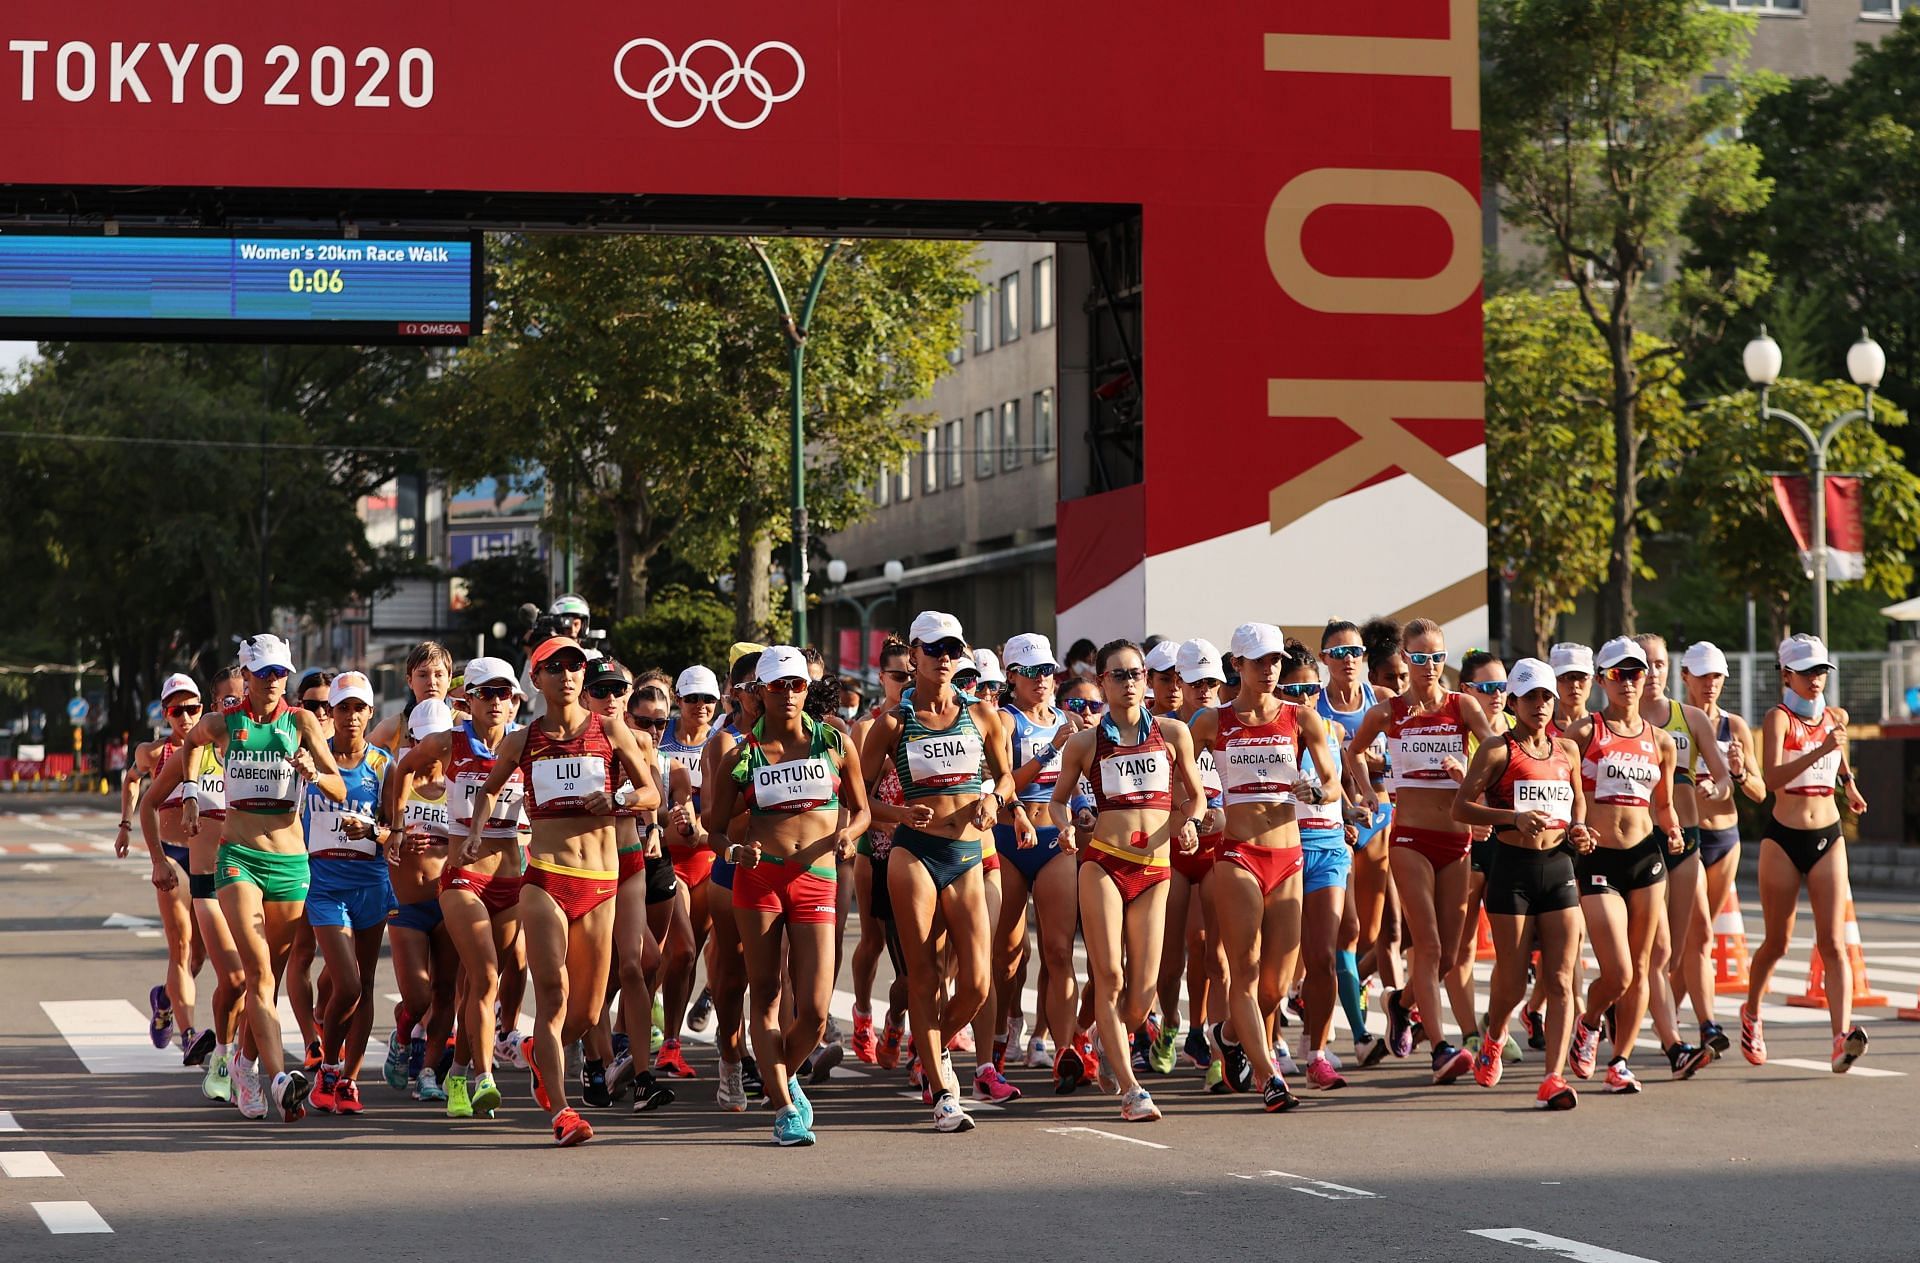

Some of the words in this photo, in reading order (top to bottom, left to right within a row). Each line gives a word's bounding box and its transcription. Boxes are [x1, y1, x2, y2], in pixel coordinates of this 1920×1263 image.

[9, 40, 244, 105] TOKYO
[263, 44, 435, 109] 2020
[240, 244, 314, 260] Women's
[318, 245, 362, 261] 20km
[366, 246, 405, 262] Race
[408, 247, 449, 263] Walk
[288, 267, 344, 294] 0:06
[420, 324, 462, 335] OMEGA
[1400, 723, 1457, 735] ESPAÑA
[1226, 734, 1291, 747] ESPAÑA
[1401, 741, 1463, 753] R.GONZALEZ
[923, 740, 966, 759] SENA
[1606, 750, 1649, 764] JAPAN
[230, 767, 292, 780] CABECINHA
[556, 763, 581, 780] LIU
[1116, 758, 1156, 777] YANG
[1258, 769, 1267, 777] 55
[1606, 764, 1652, 782] OKADA
[760, 764, 825, 786] ORTUNO
[255, 784, 269, 793] 160
[564, 783, 574, 791] 20
[1133, 778, 1143, 786] 23
[787, 786, 802, 795] 141
[1519, 786, 1570, 801] BEKMEZ
